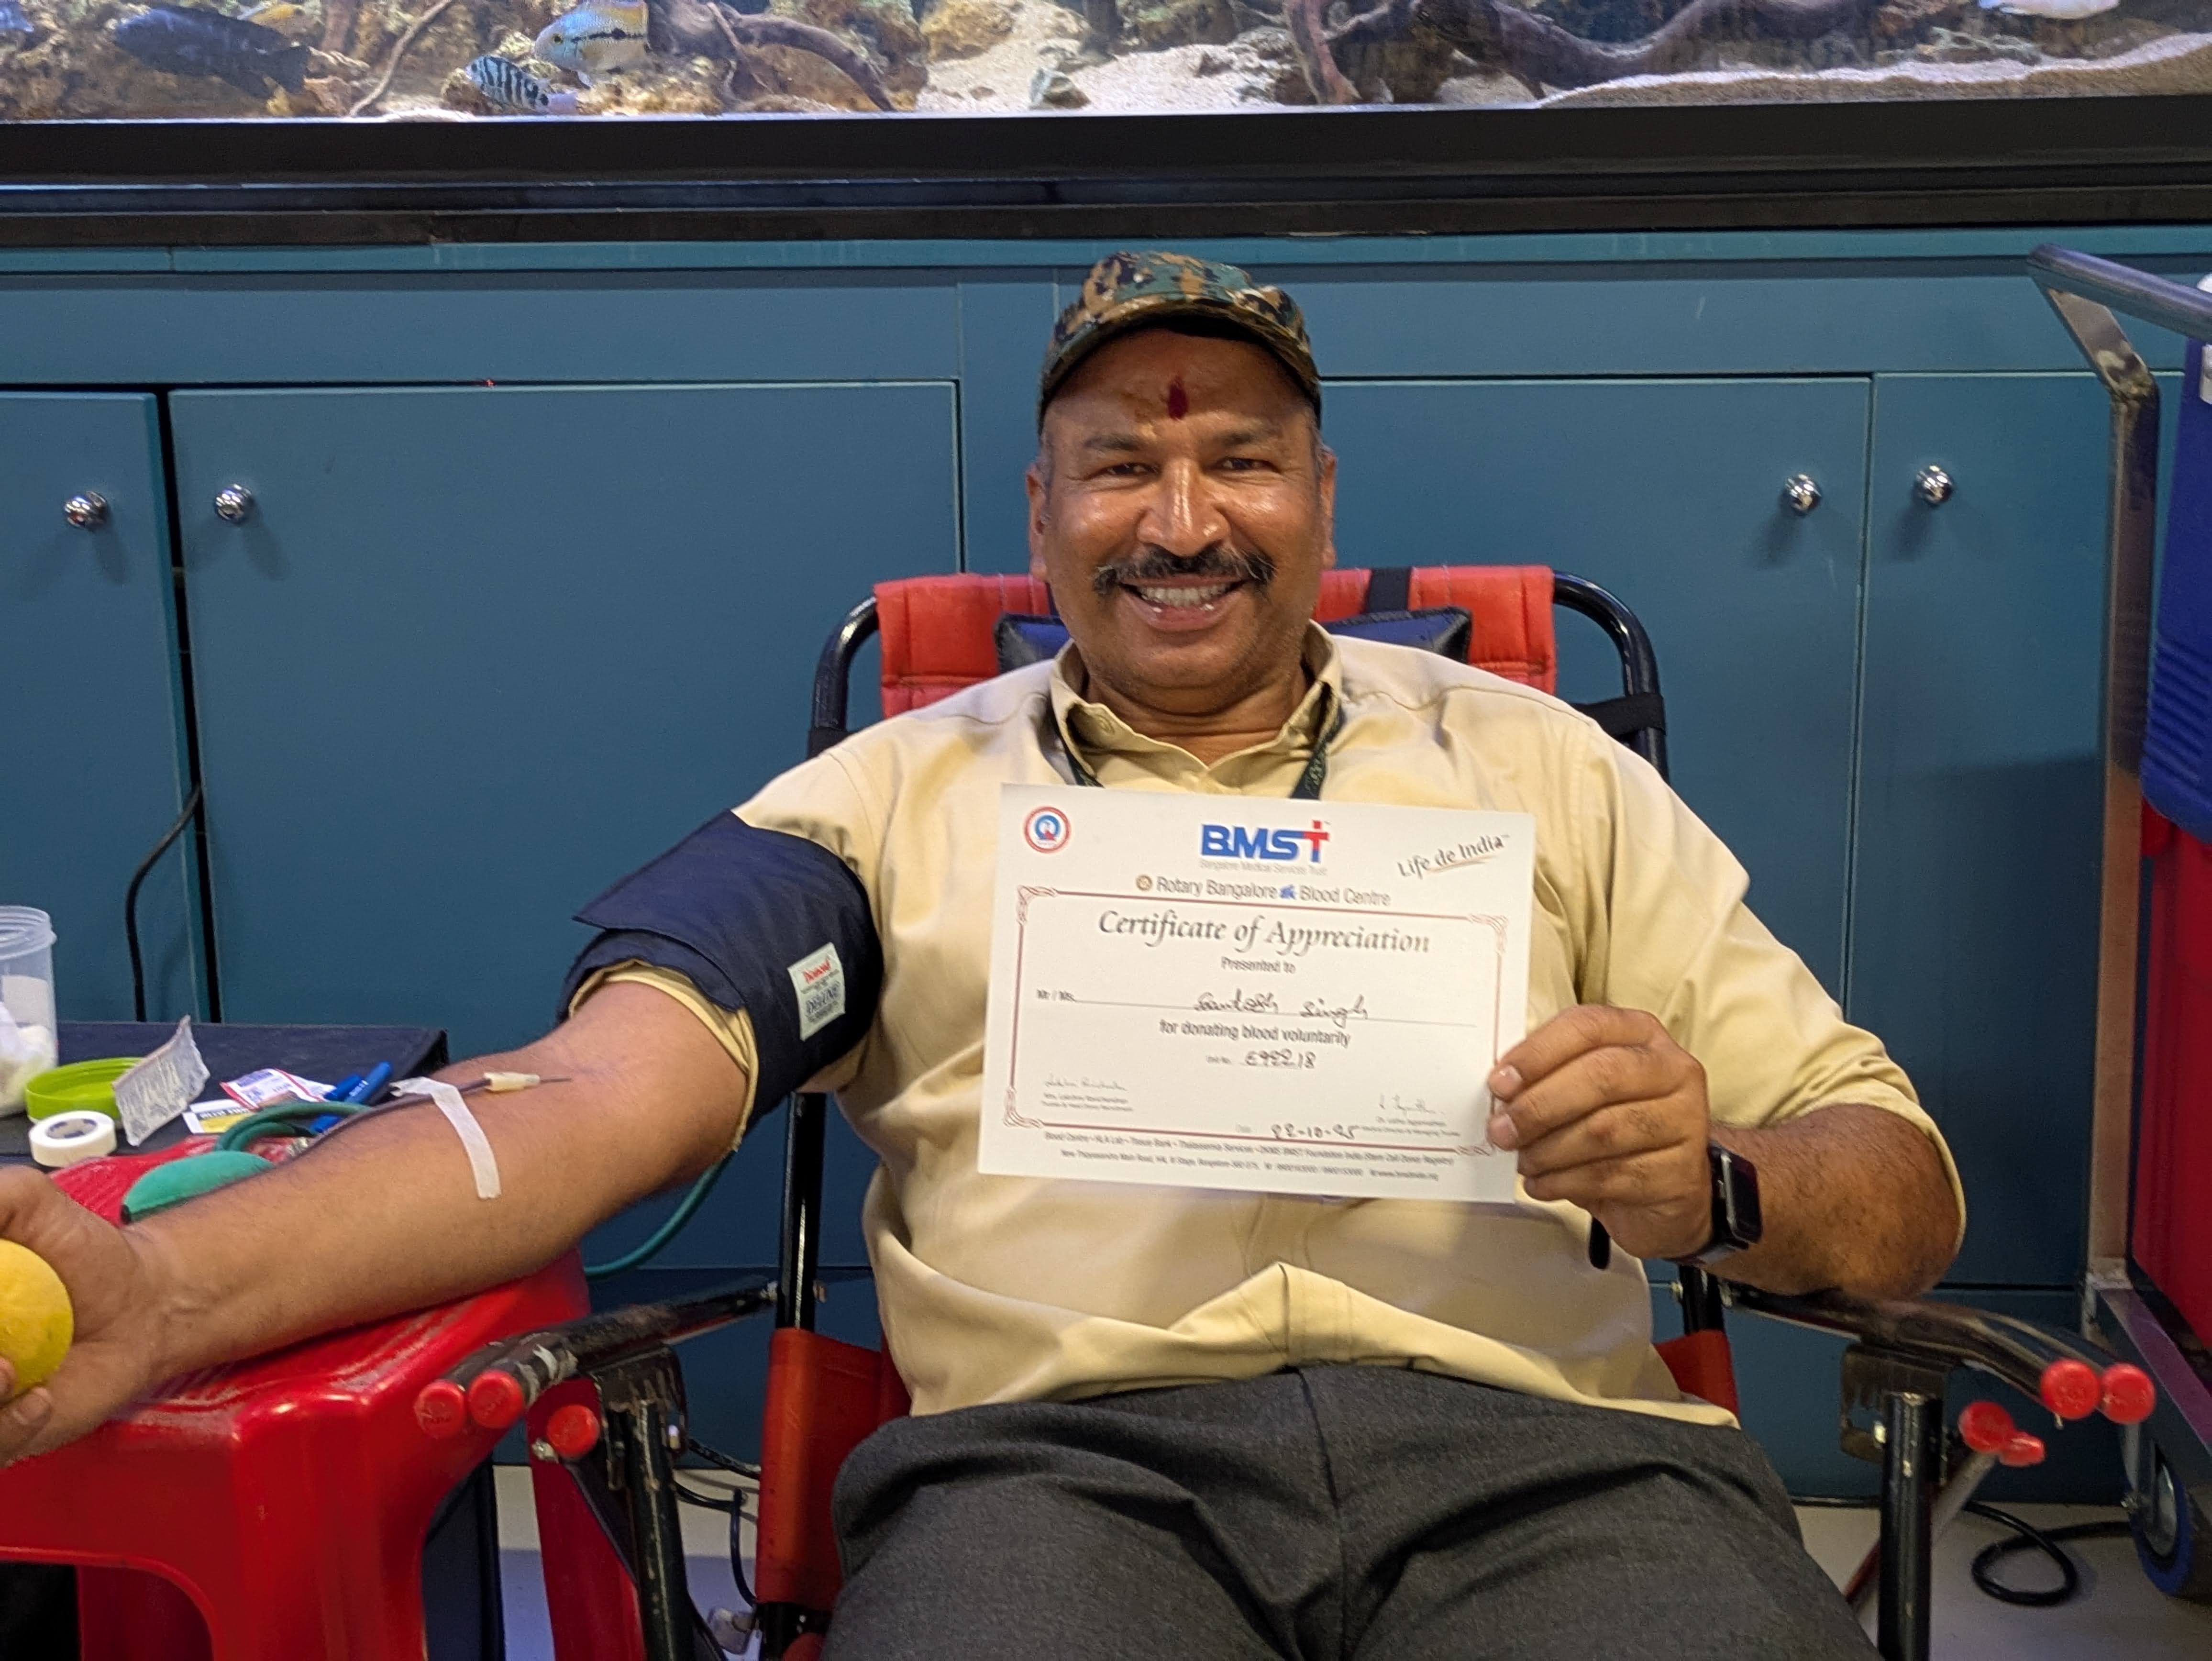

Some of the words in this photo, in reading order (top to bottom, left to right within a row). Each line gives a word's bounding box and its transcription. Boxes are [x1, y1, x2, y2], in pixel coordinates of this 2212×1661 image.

[1201, 819, 1329, 863] BMST
[1397, 854, 1430, 880] Life
[1435, 848, 1456, 867] de
[1458, 836, 1504, 859] India
[1157, 875, 1203, 897] Rotary
[1206, 879, 1278, 900] Bangalore
[1300, 885, 1339, 902] Blood
[1344, 888, 1391, 907] Centre
[1099, 909, 1227, 947] Certificate
[1233, 915, 1265, 952] of
[1264, 920, 1429, 956] Appreciation
[1221, 956, 1281, 974] Presented
[1281, 961, 1296, 974] to
[1159, 1019, 1178, 1035] for
[1181, 1020, 1239, 1041] donating
[1241, 1023, 1279, 1041] blood
[1282, 1029, 1351, 1048] voluntarily
